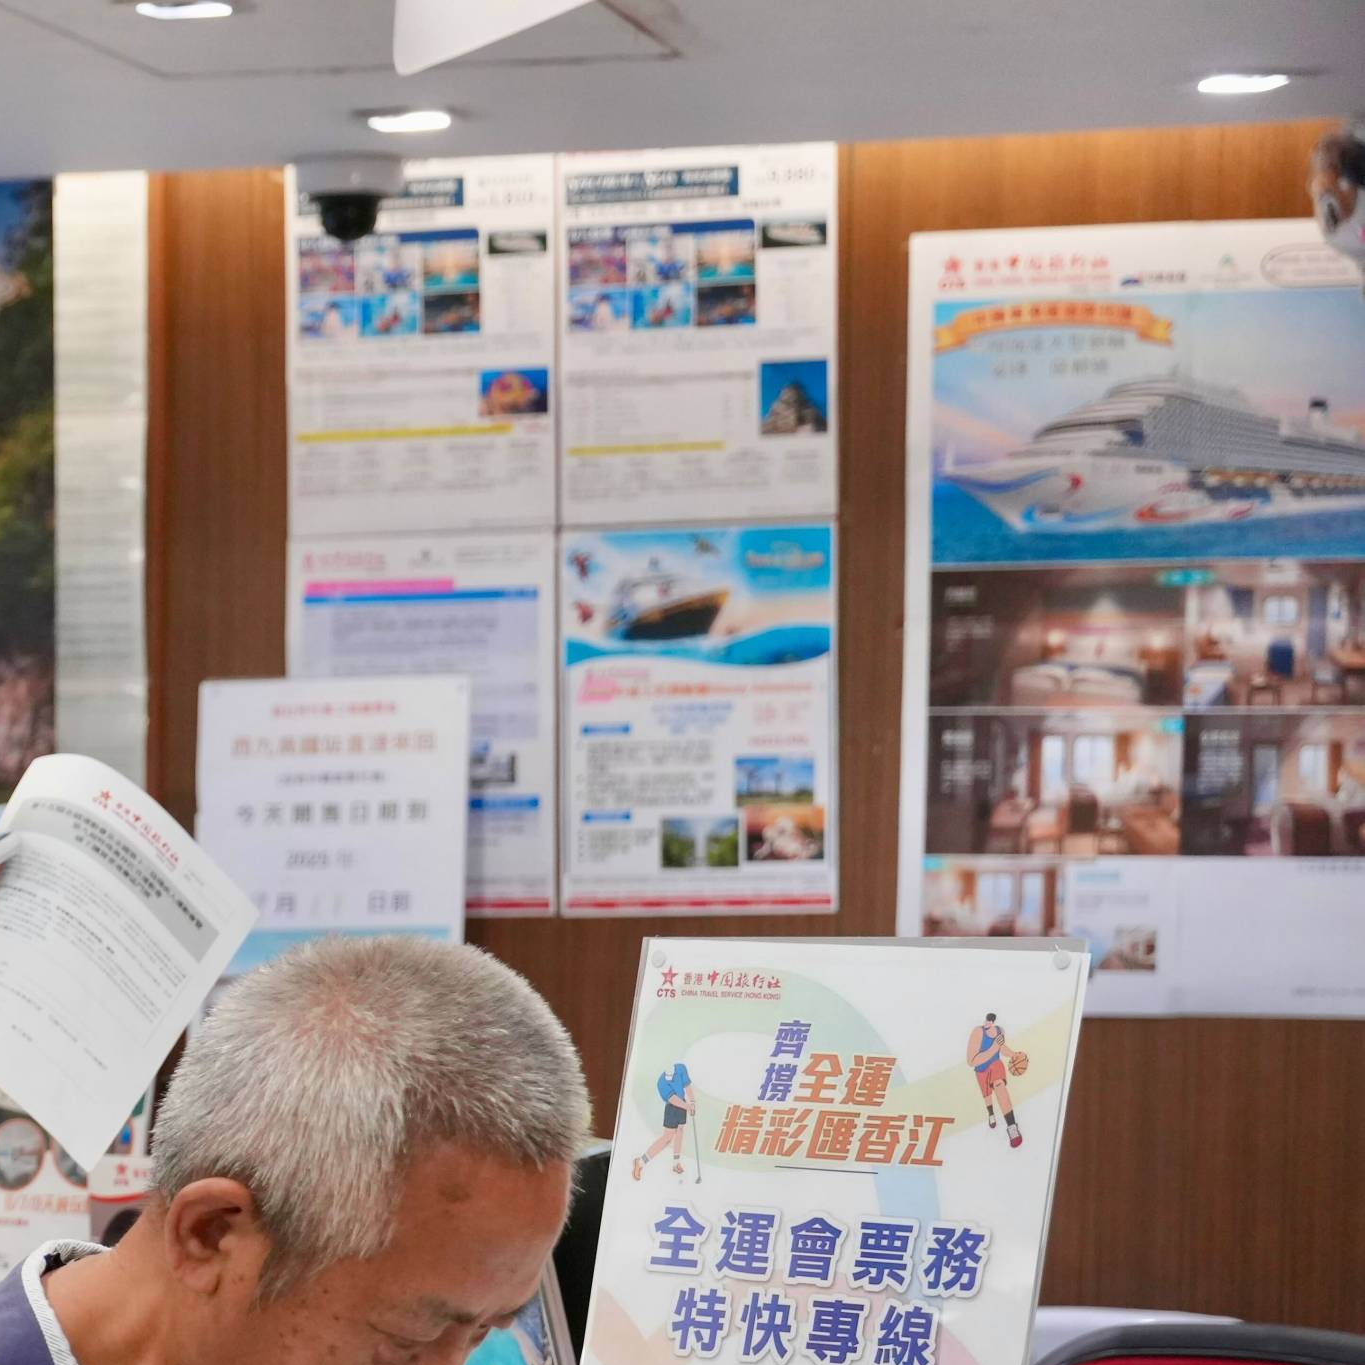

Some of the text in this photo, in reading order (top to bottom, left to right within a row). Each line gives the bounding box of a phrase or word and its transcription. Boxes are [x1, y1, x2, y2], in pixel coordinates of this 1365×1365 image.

[656, 988, 676, 998] CTS
[715, 1103, 955, 1167] 精彩匯香江
[650, 1205, 987, 1295] 全運會票務
